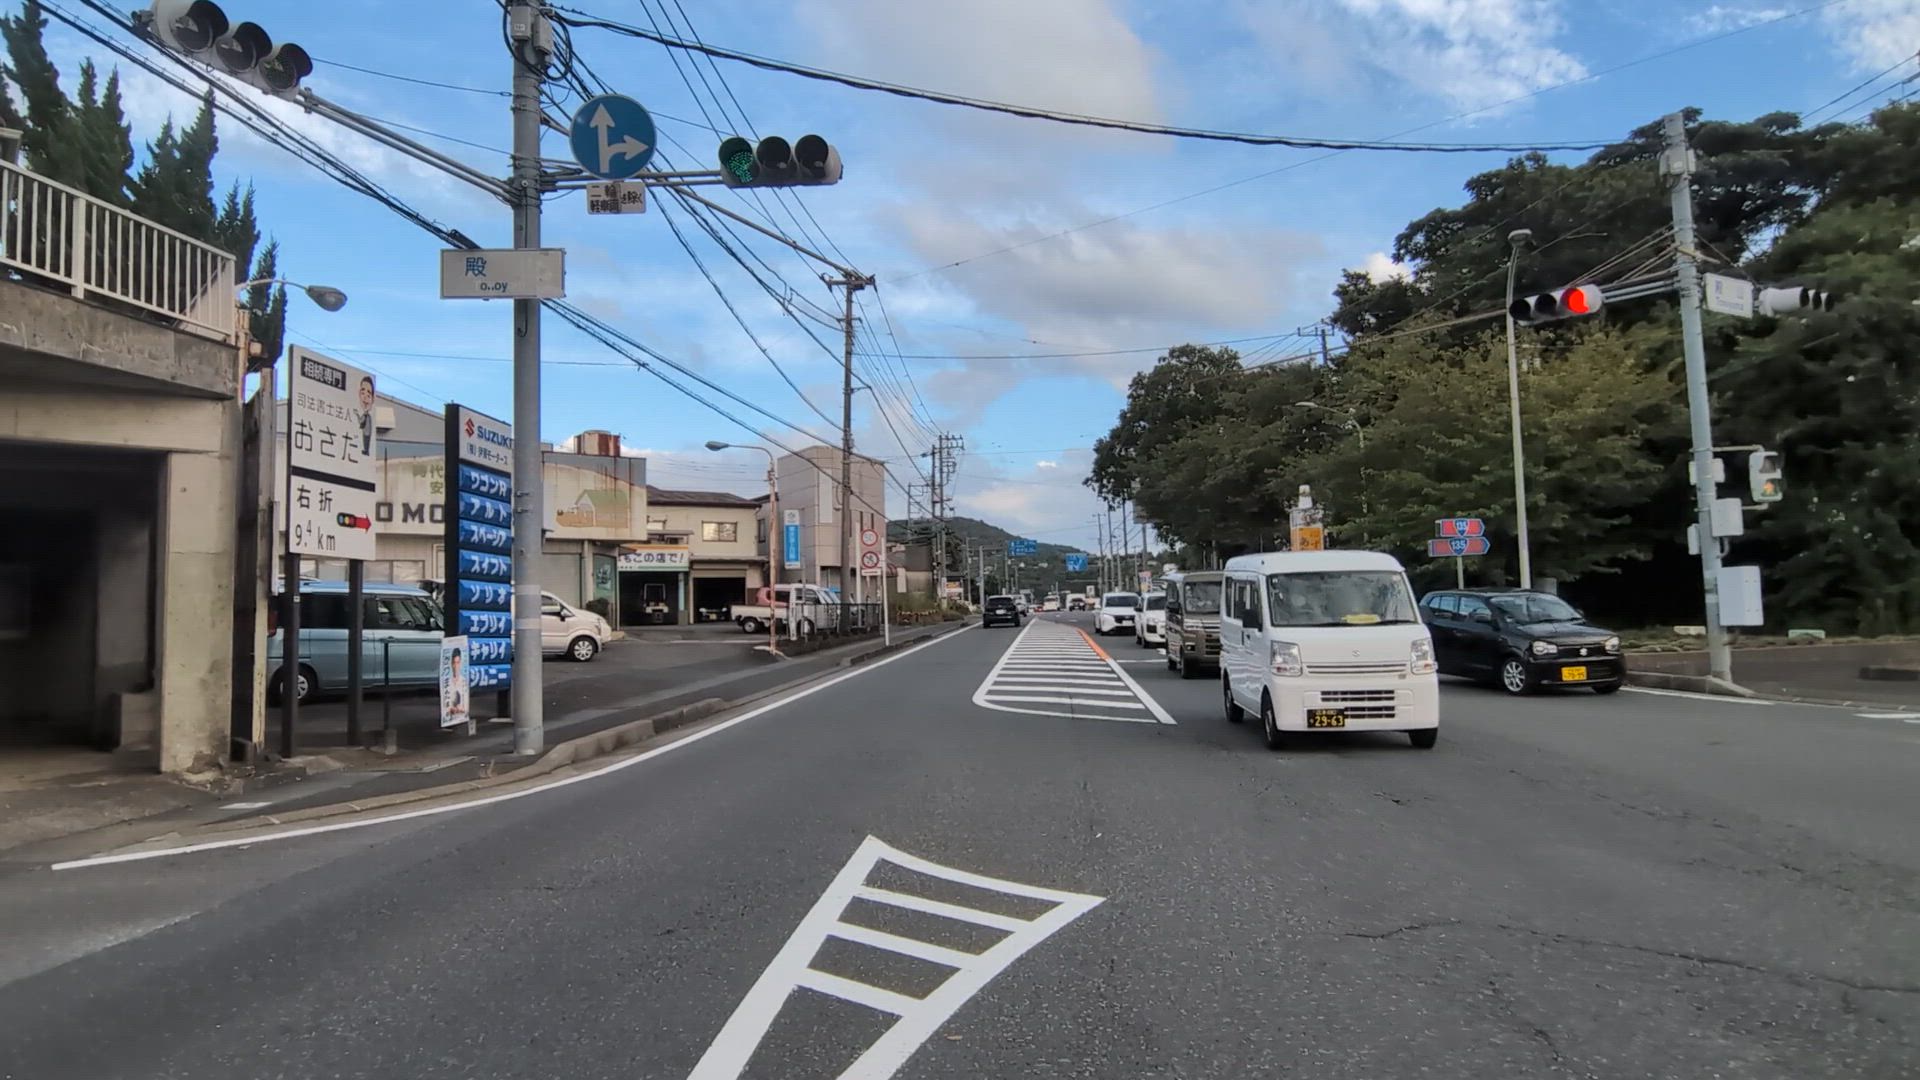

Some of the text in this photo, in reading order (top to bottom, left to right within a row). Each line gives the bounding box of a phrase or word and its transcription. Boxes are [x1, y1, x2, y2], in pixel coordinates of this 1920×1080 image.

[464, 256, 487, 277] 殿
[296, 391, 353, 423] 司法書士法人
[294, 418, 359, 464] おさだ
[477, 425, 514, 449] SUZUKI
[470, 471, 507, 497] ワゴンR
[296, 484, 333, 513] 右折
[1451, 539, 1466, 550] 135
[469, 554, 507, 576] スイフト
[470, 584, 507, 606] ソリオ
[469, 613, 506, 634] エブリイ
[470, 640, 506, 661] キャリイ
[470, 667, 508, 688] ジムニー
[1314, 715, 1343, 726] 29-63
